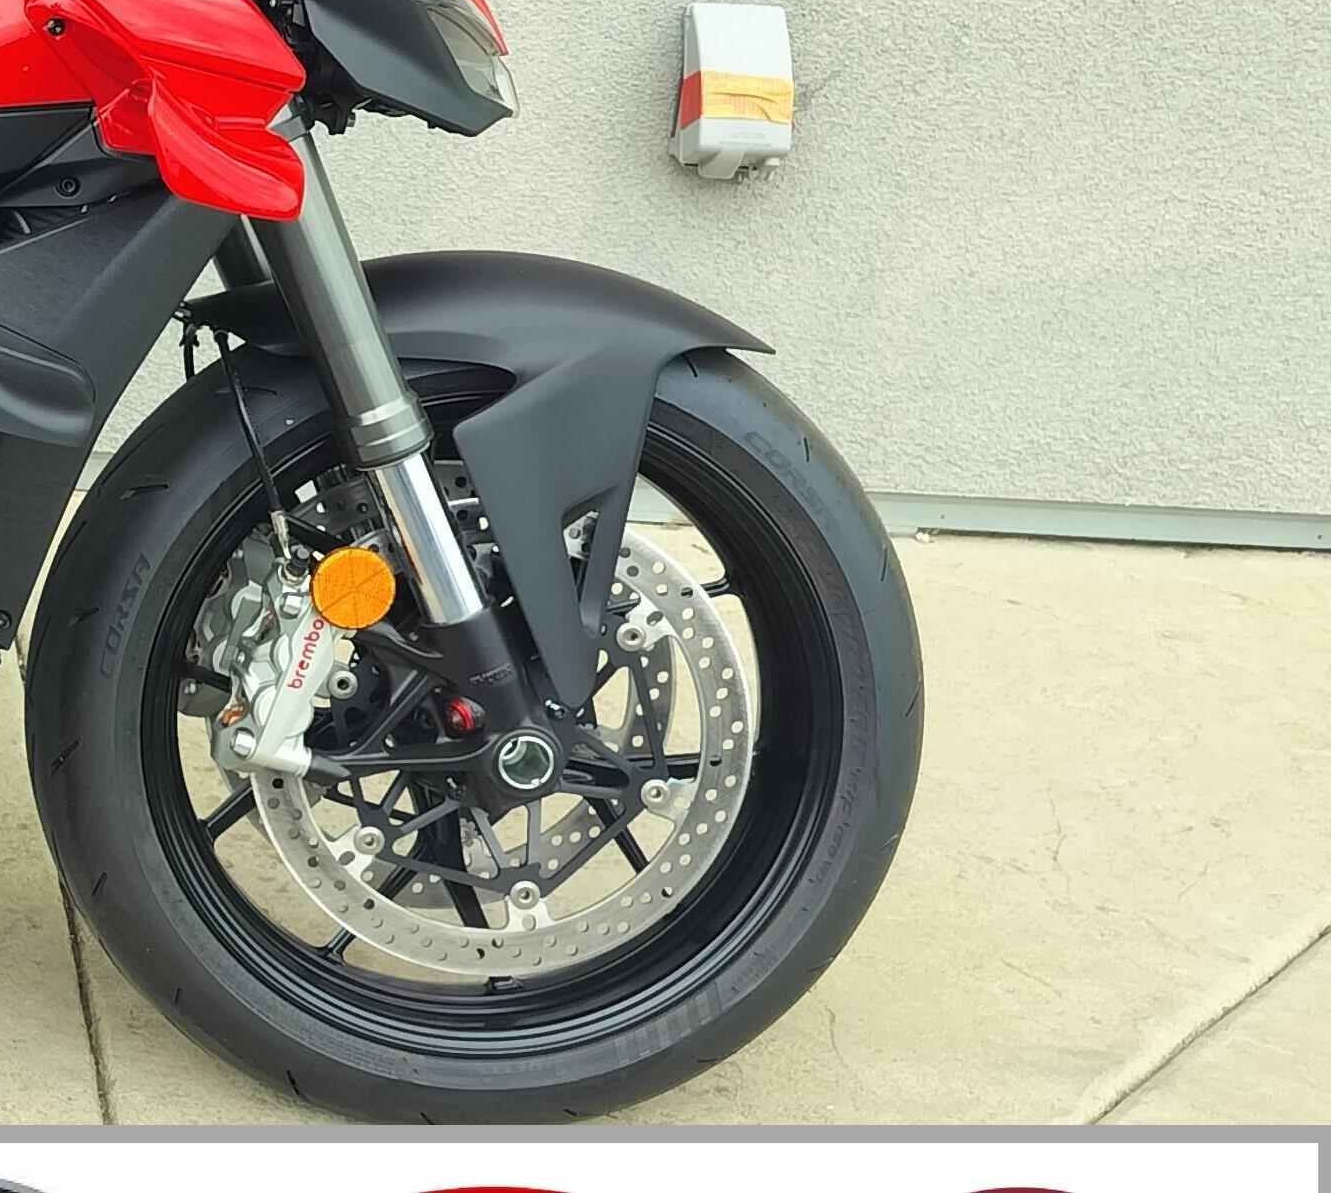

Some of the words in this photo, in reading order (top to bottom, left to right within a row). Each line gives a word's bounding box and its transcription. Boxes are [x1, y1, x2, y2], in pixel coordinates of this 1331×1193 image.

[742, 429, 842, 529] CORSA
[100, 553, 152, 677] CORSA
[286, 619, 325, 689] brembo
